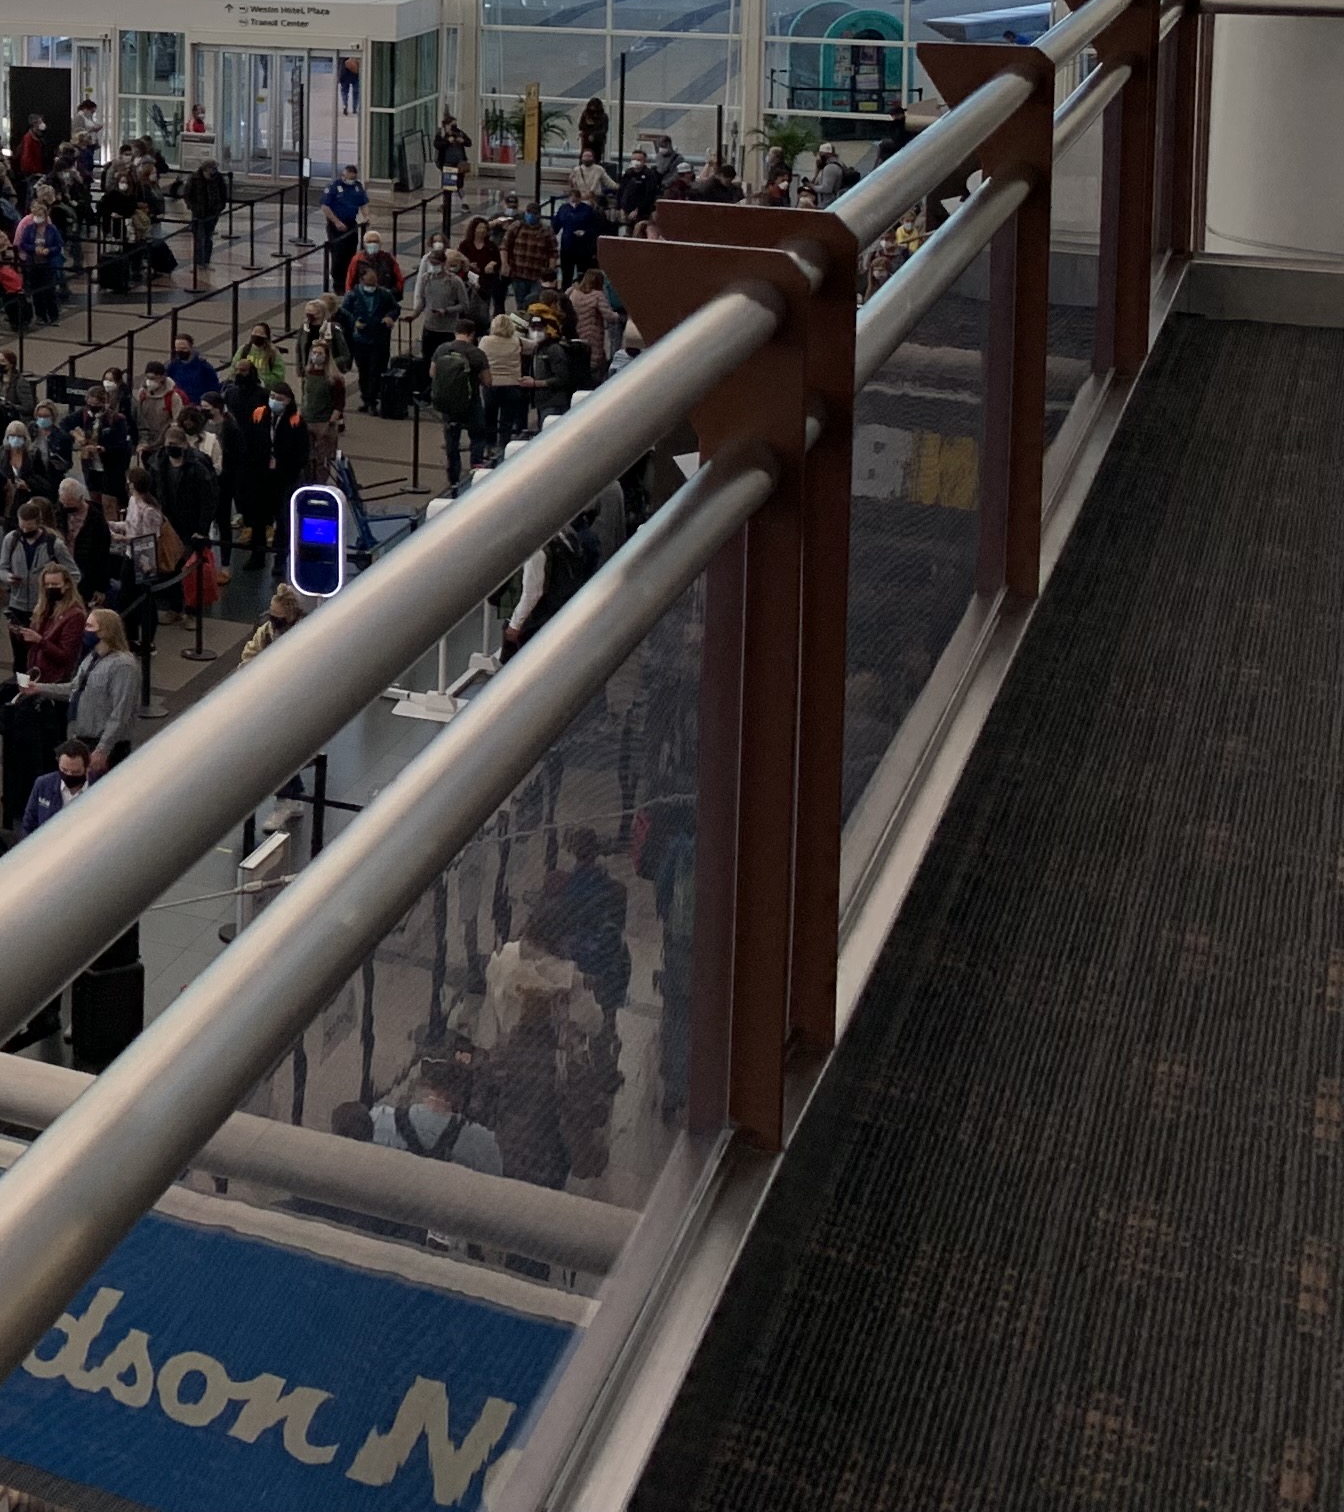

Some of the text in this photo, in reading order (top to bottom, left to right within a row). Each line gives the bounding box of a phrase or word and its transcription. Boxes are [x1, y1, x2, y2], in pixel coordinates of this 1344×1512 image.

[250, 5, 278, 14] Westin
[307, 7, 330, 16] Plaza
[250, 18, 309, 28] Transit Center
